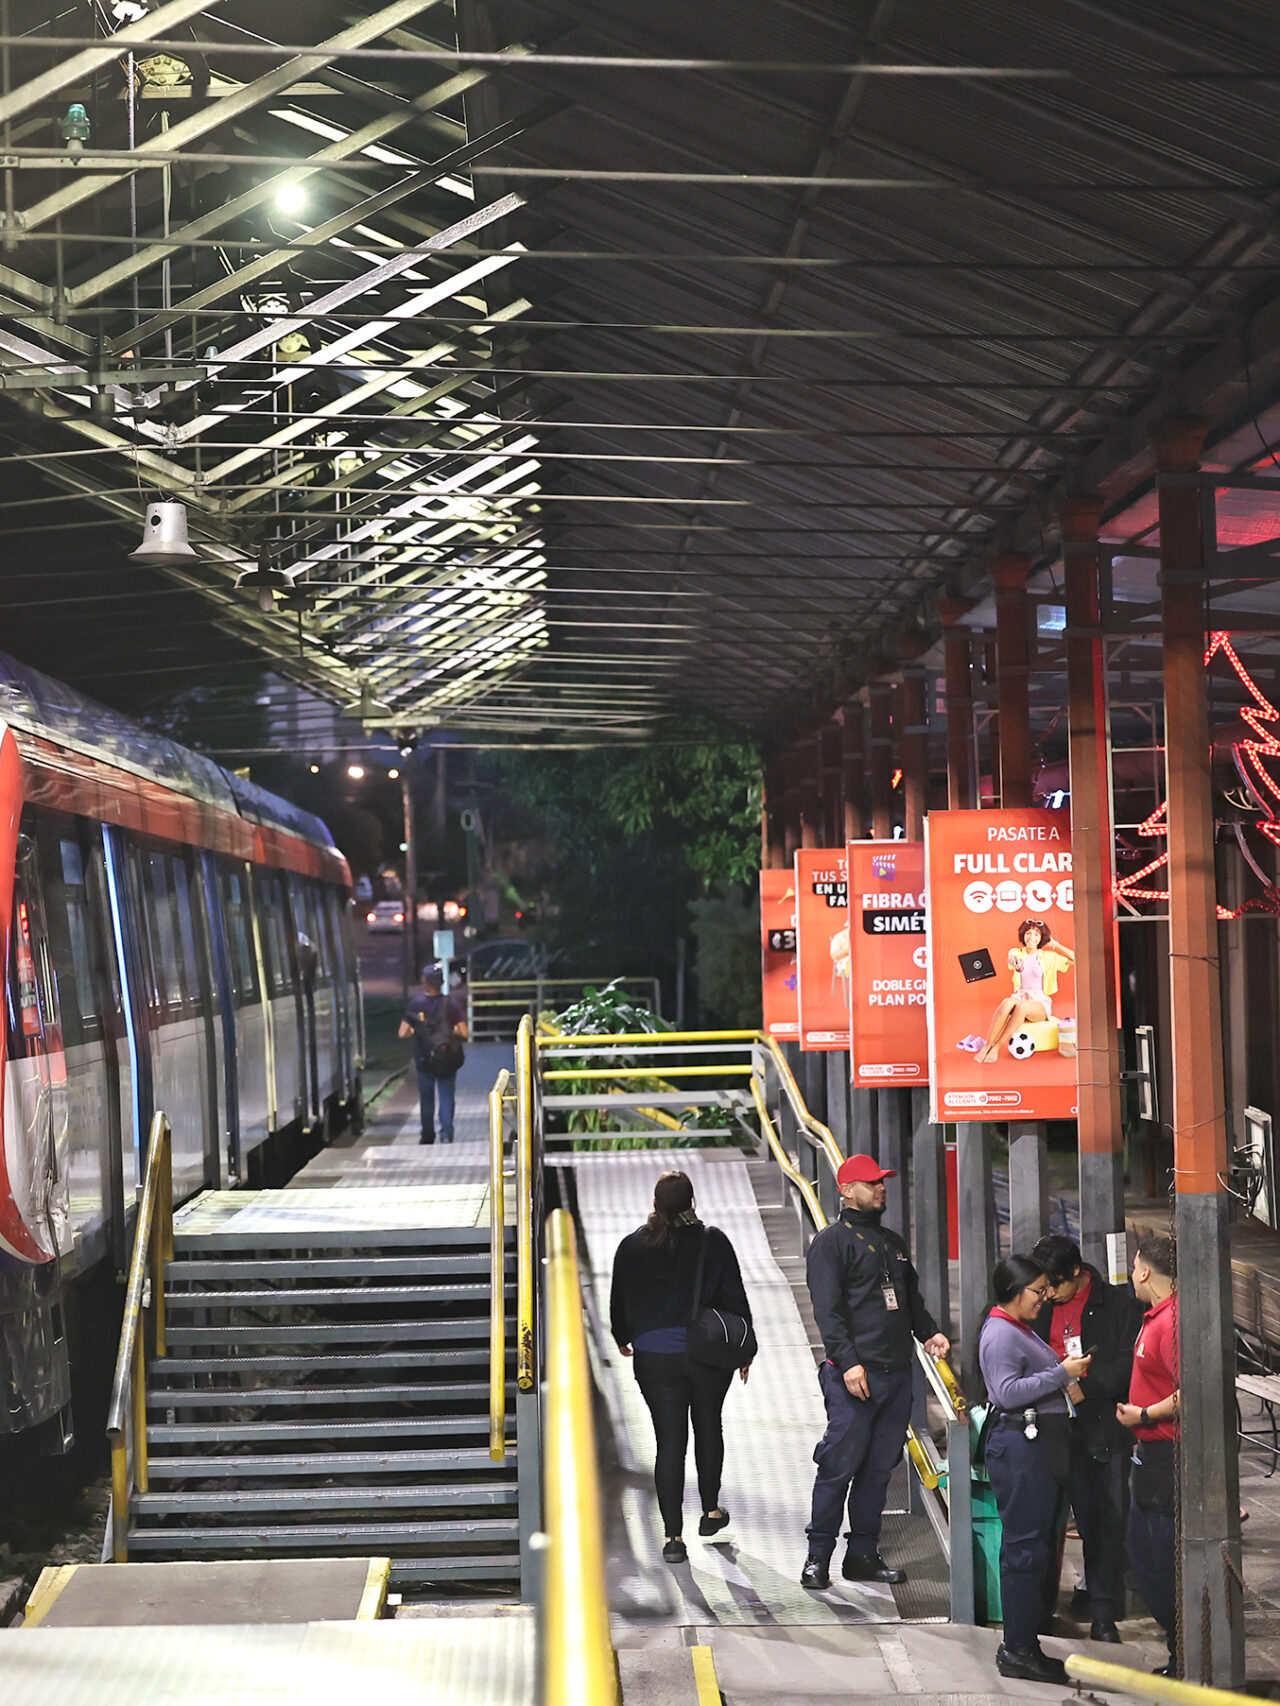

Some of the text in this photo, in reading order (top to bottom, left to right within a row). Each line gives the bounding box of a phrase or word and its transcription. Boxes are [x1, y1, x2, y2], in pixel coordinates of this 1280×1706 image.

[987, 826, 1060, 841] PASATE A
[953, 853, 1011, 874] FULL
[812, 871, 837, 882] TUS
[816, 883, 833, 895] EN
[862, 892, 916, 909] FIBRA
[872, 979, 913, 992] DOBLE
[868, 993, 905, 1006] PLAN
